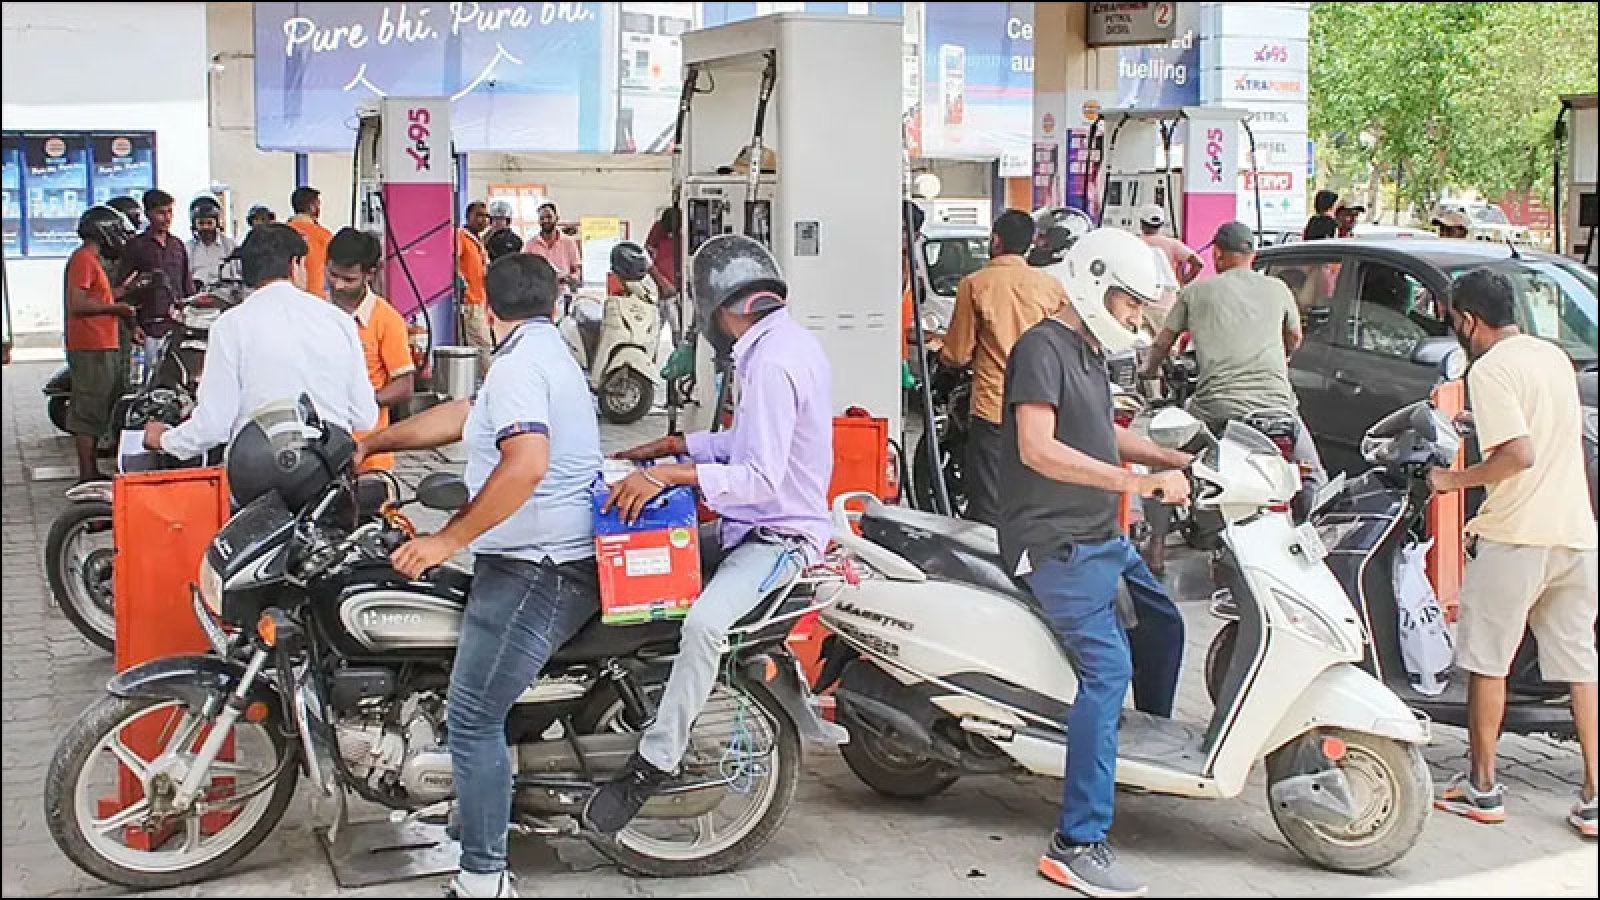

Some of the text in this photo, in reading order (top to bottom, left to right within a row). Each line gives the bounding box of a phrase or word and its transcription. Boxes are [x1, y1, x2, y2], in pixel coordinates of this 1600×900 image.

[283, 17, 368, 57] Pure
[377, 3, 438, 45] bhi.
[450, 2, 532, 35] Pura
[1157, 3, 1170, 25] 2
[1119, 56, 1187, 85] fuelling
[406, 107, 430, 171] XP95
[1204, 127, 1223, 183] XP95
